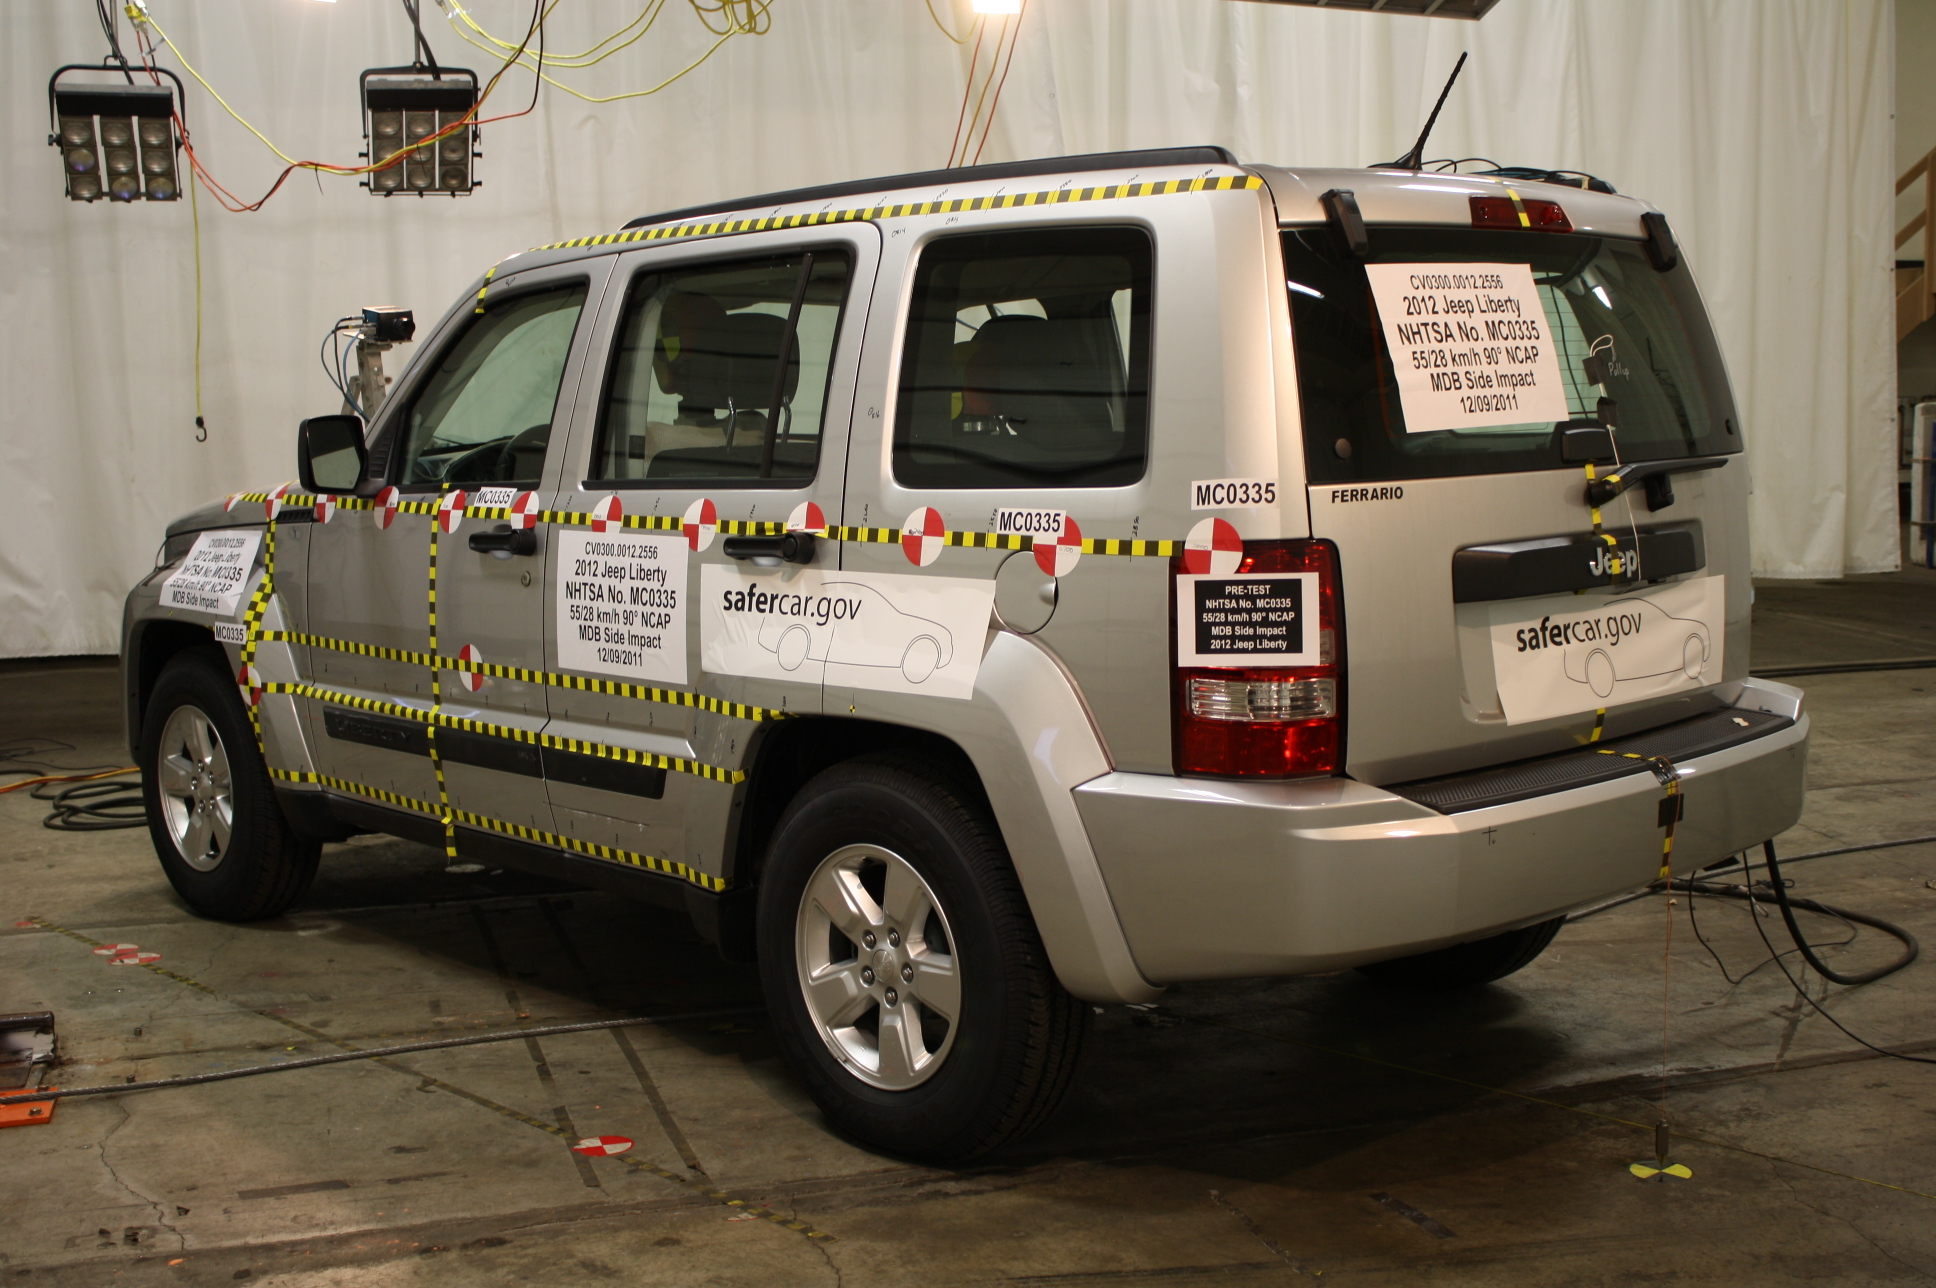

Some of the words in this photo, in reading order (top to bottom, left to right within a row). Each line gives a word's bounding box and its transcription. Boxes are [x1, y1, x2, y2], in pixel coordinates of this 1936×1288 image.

[1410, 274, 1503, 290] CV0300.0012.2556
[1403, 295, 1439, 316] 2012
[1442, 295, 1474, 319] Jeep
[1475, 294, 1521, 318] Liberty
[1397, 321, 1456, 345] NHTSA
[1456, 321, 1484, 342] No.
[1484, 320, 1540, 341] MC0335
[1412, 349, 1448, 370] 55/28
[1449, 347, 1482, 367] km/h
[1483, 346, 1502, 366] 90°
[1505, 345, 1539, 364] NCAP
[1430, 371, 1462, 392] MDB
[1464, 370, 1493, 390] Side
[1494, 369, 1536, 392] Impact
[1460, 393, 1518, 414] 12/09/2011
[476, 490, 513, 504] MC0335
[1197, 483, 1276, 506] MC0335
[1332, 486, 1403, 504] FERRARIO
[999, 512, 1061, 533] MC0335
[585, 541, 658, 560] CV0300.0012.2556
[575, 559, 598, 577] 2012
[601, 561, 626, 584] Jeep
[629, 563, 667, 587] Liberty
[208, 582, 233, 595] NCAP
[566, 581, 604, 602] NHTSA
[608, 584, 626, 604] No.
[630, 586, 676, 609] MC0335
[1225, 585, 1271, 595] PRE-TEST
[172, 590, 186, 604] MDB
[185, 592, 198, 606] Side
[199, 594, 219, 611] Impact
[723, 583, 862, 626] safercar.gov
[1206, 599, 1237, 609] NHTSA
[1239, 599, 1254, 608] No.
[1256, 598, 1291, 608] MC0335
[570, 604, 594, 622] 55/28
[597, 606, 620, 625] km/h
[623, 609, 638, 626] 90°
[641, 611, 671, 630] NCAP
[1203, 612, 1225, 622] 55/28
[1228, 612, 1249, 622] km/h
[1251, 612, 1266, 622] 90°
[1269, 611, 1295, 621] NCAP
[215, 625, 244, 641] MC0335
[579, 624, 601, 642] MDB
[604, 627, 625, 645] Side
[628, 629, 661, 651] Impact
[1211, 626, 1232, 635] MDB
[1234, 625, 1254, 635] Side
[1256, 625, 1286, 637] Impact
[1516, 612, 1642, 653] safercar.gov
[1210, 639, 1231, 649] 2012
[1233, 639, 1254, 651] Jeep
[1256, 639, 1287, 651] Liberty
[597, 647, 642, 667] 12/09/2011
